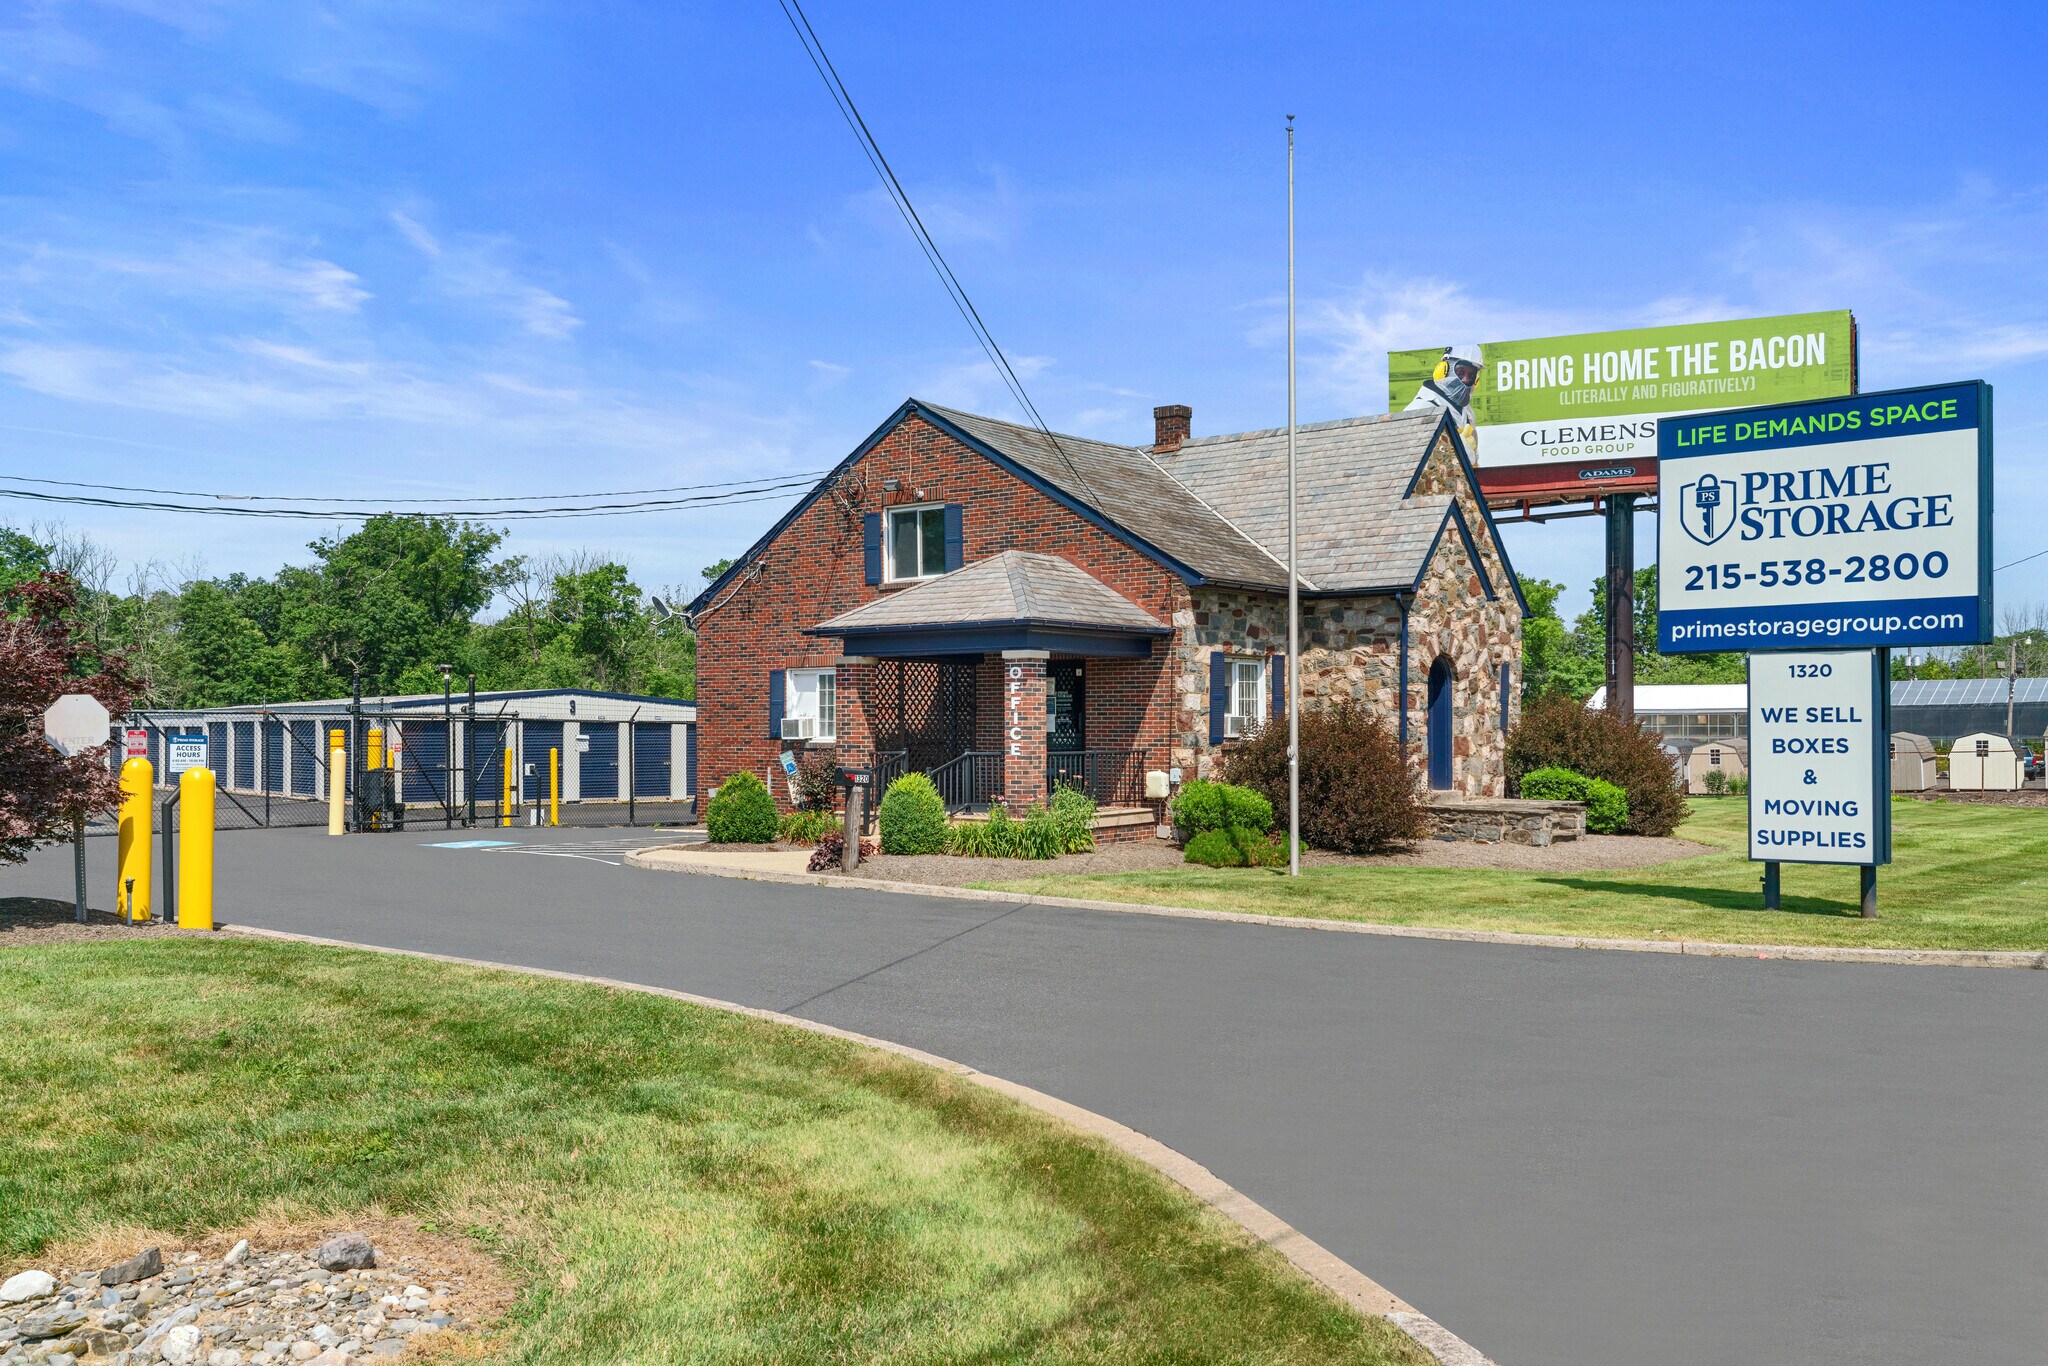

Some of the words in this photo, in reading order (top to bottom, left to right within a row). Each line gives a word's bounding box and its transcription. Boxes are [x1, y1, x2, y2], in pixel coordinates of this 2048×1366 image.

[1497, 355, 1574, 392] BRING
[1583, 347, 1659, 384] HOME
[1665, 342, 1719, 378] THE
[1730, 332, 1826, 372] BACON
[1559, 385, 1628, 406] (LITERALLY
[1632, 383, 1657, 400] AND
[1661, 376, 1756, 399] FIGURATIVELY)
[1677, 425, 1727, 447] LIFE
[1735, 410, 1862, 441] DEMANDS
[1869, 399, 1958, 427] SPACE
[1520, 421, 1656, 447] CLEMENS
[1541, 446, 1580, 457] FOOD
[1585, 442, 1635, 455] GROUP
[1584, 468, 1632, 478] ADAMS
[1740, 462, 1892, 506] PRIME
[1701, 491, 1715, 502] PS
[1740, 494, 1954, 541] STORAGE
[1684, 550, 1949, 591] 215-538-2800
[1671, 612, 1964, 642] primestoragegroup.com
[1788, 663, 1832, 678] 1320
[1009, 666, 1022, 756] OFFICE
[1760, 707, 1798, 723] WE
[1806, 706, 1862, 723] SELL
[62, 736, 95, 746] ENTER
[1772, 738, 1849, 754] BOXES
[855, 775, 869, 783] 1320
[1803, 769, 1817, 785] &
[1764, 799, 1859, 816] MOVING
[1757, 829, 1866, 849] SUPPLIES
